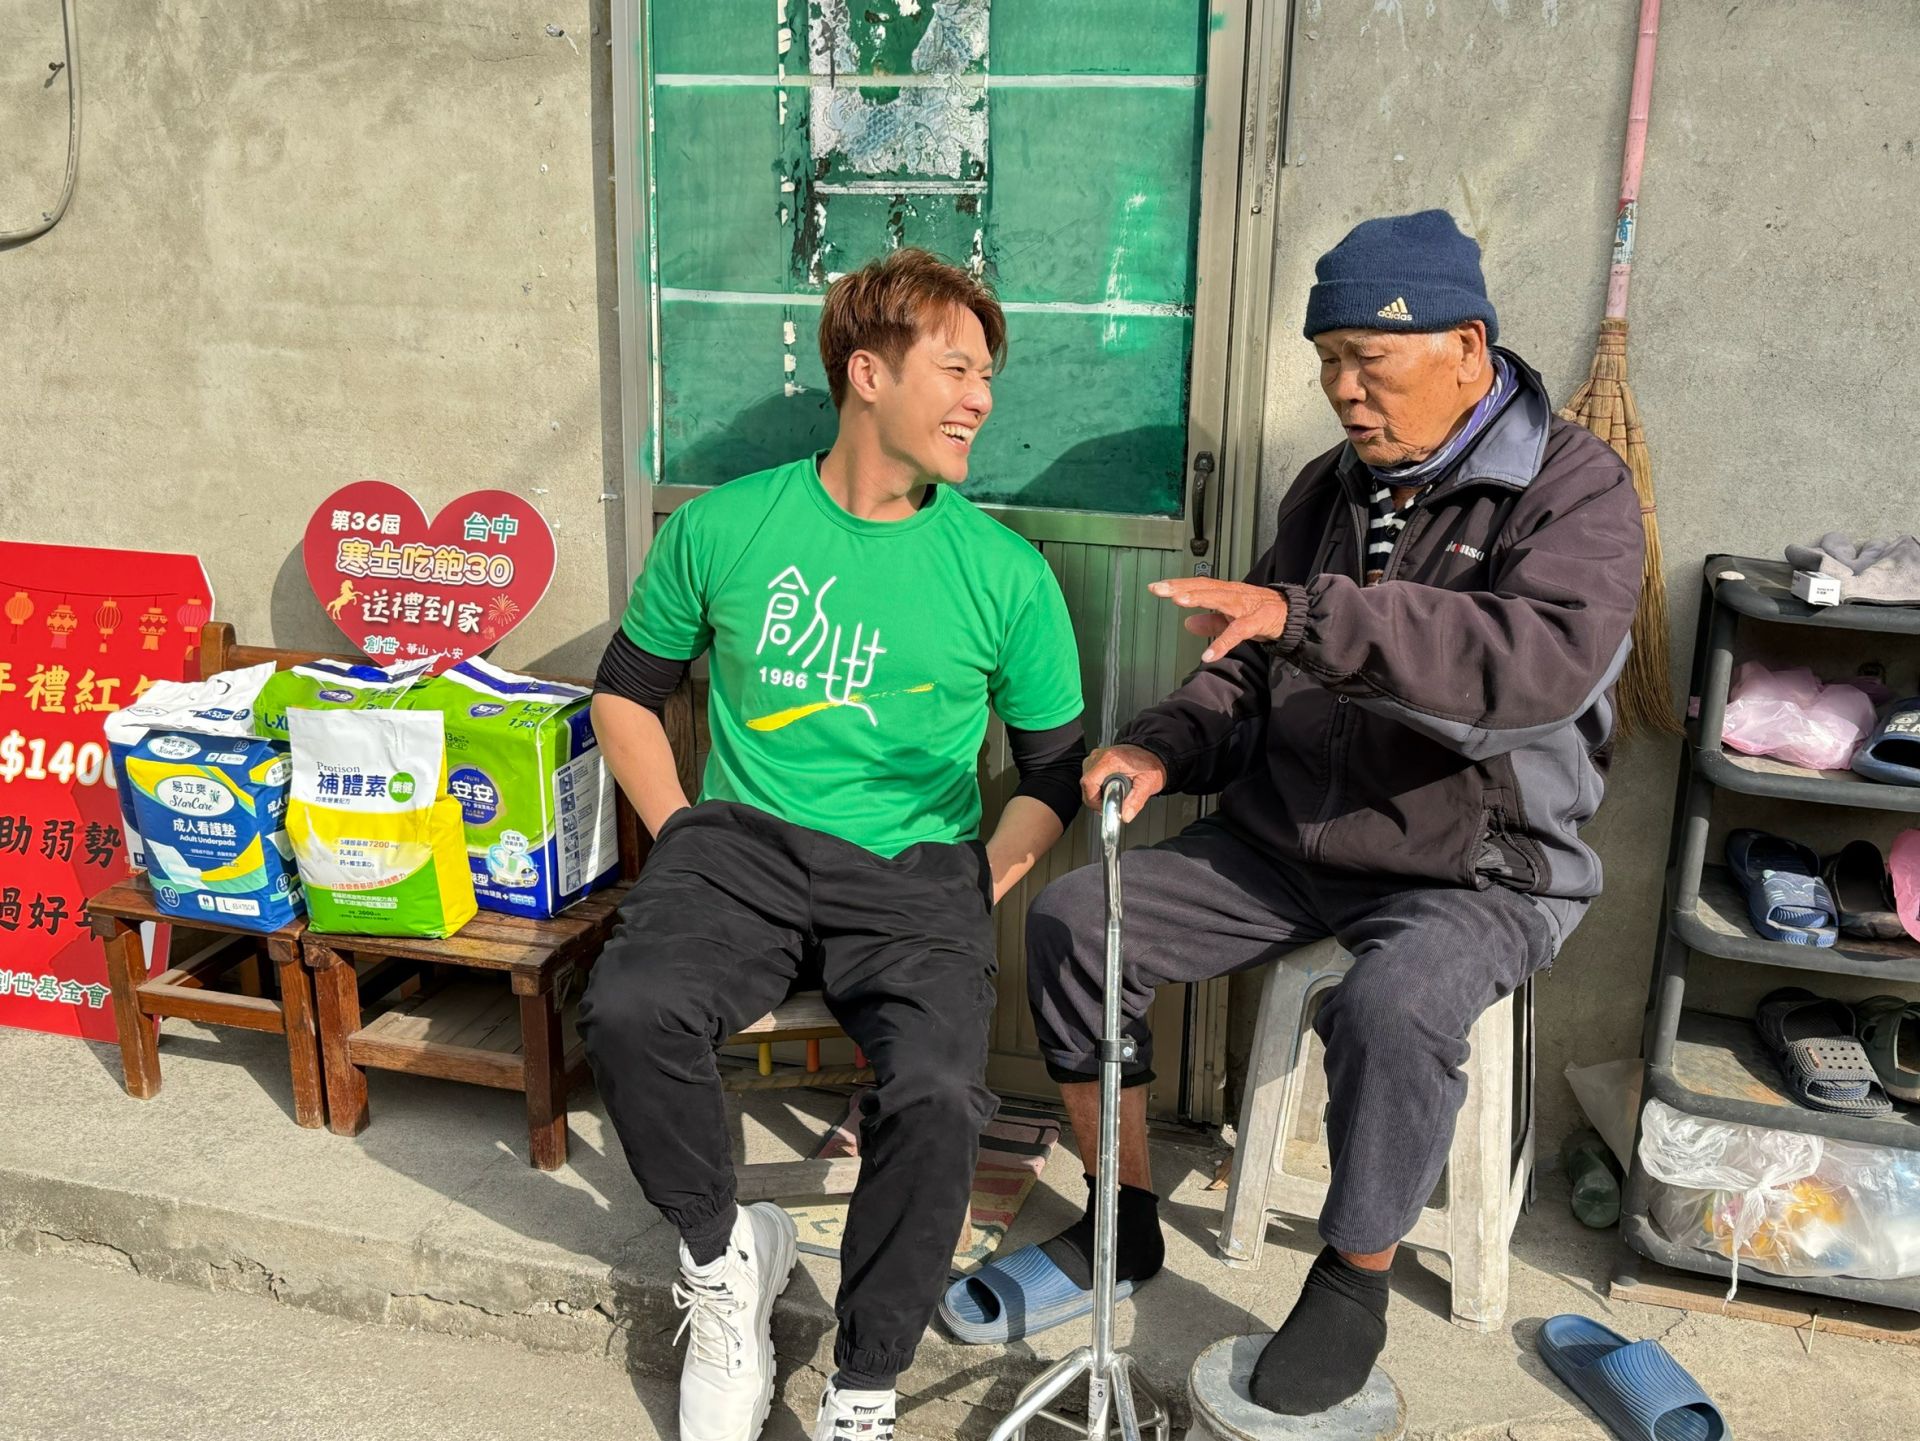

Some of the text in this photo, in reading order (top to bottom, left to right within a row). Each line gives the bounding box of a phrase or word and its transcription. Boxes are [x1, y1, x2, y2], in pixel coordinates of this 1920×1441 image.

[1377, 310, 1413, 321] adidas
[331, 509, 401, 535] 第36屆
[464, 512, 518, 543] 台中
[336, 538, 514, 587] 寒士吃飽30
[361, 588, 483, 633] 送禮到家
[758, 665, 808, 690] 1986
[172, 780, 207, 796] 易立爽
[317, 772, 387, 797] 補體素
[452, 779, 494, 803] 安安
[169, 795, 214, 811] StarCare
[173, 818, 237, 838] 成人看護墊
[179, 834, 236, 847] Adult Underpads
[164, 887, 176, 899] 10
